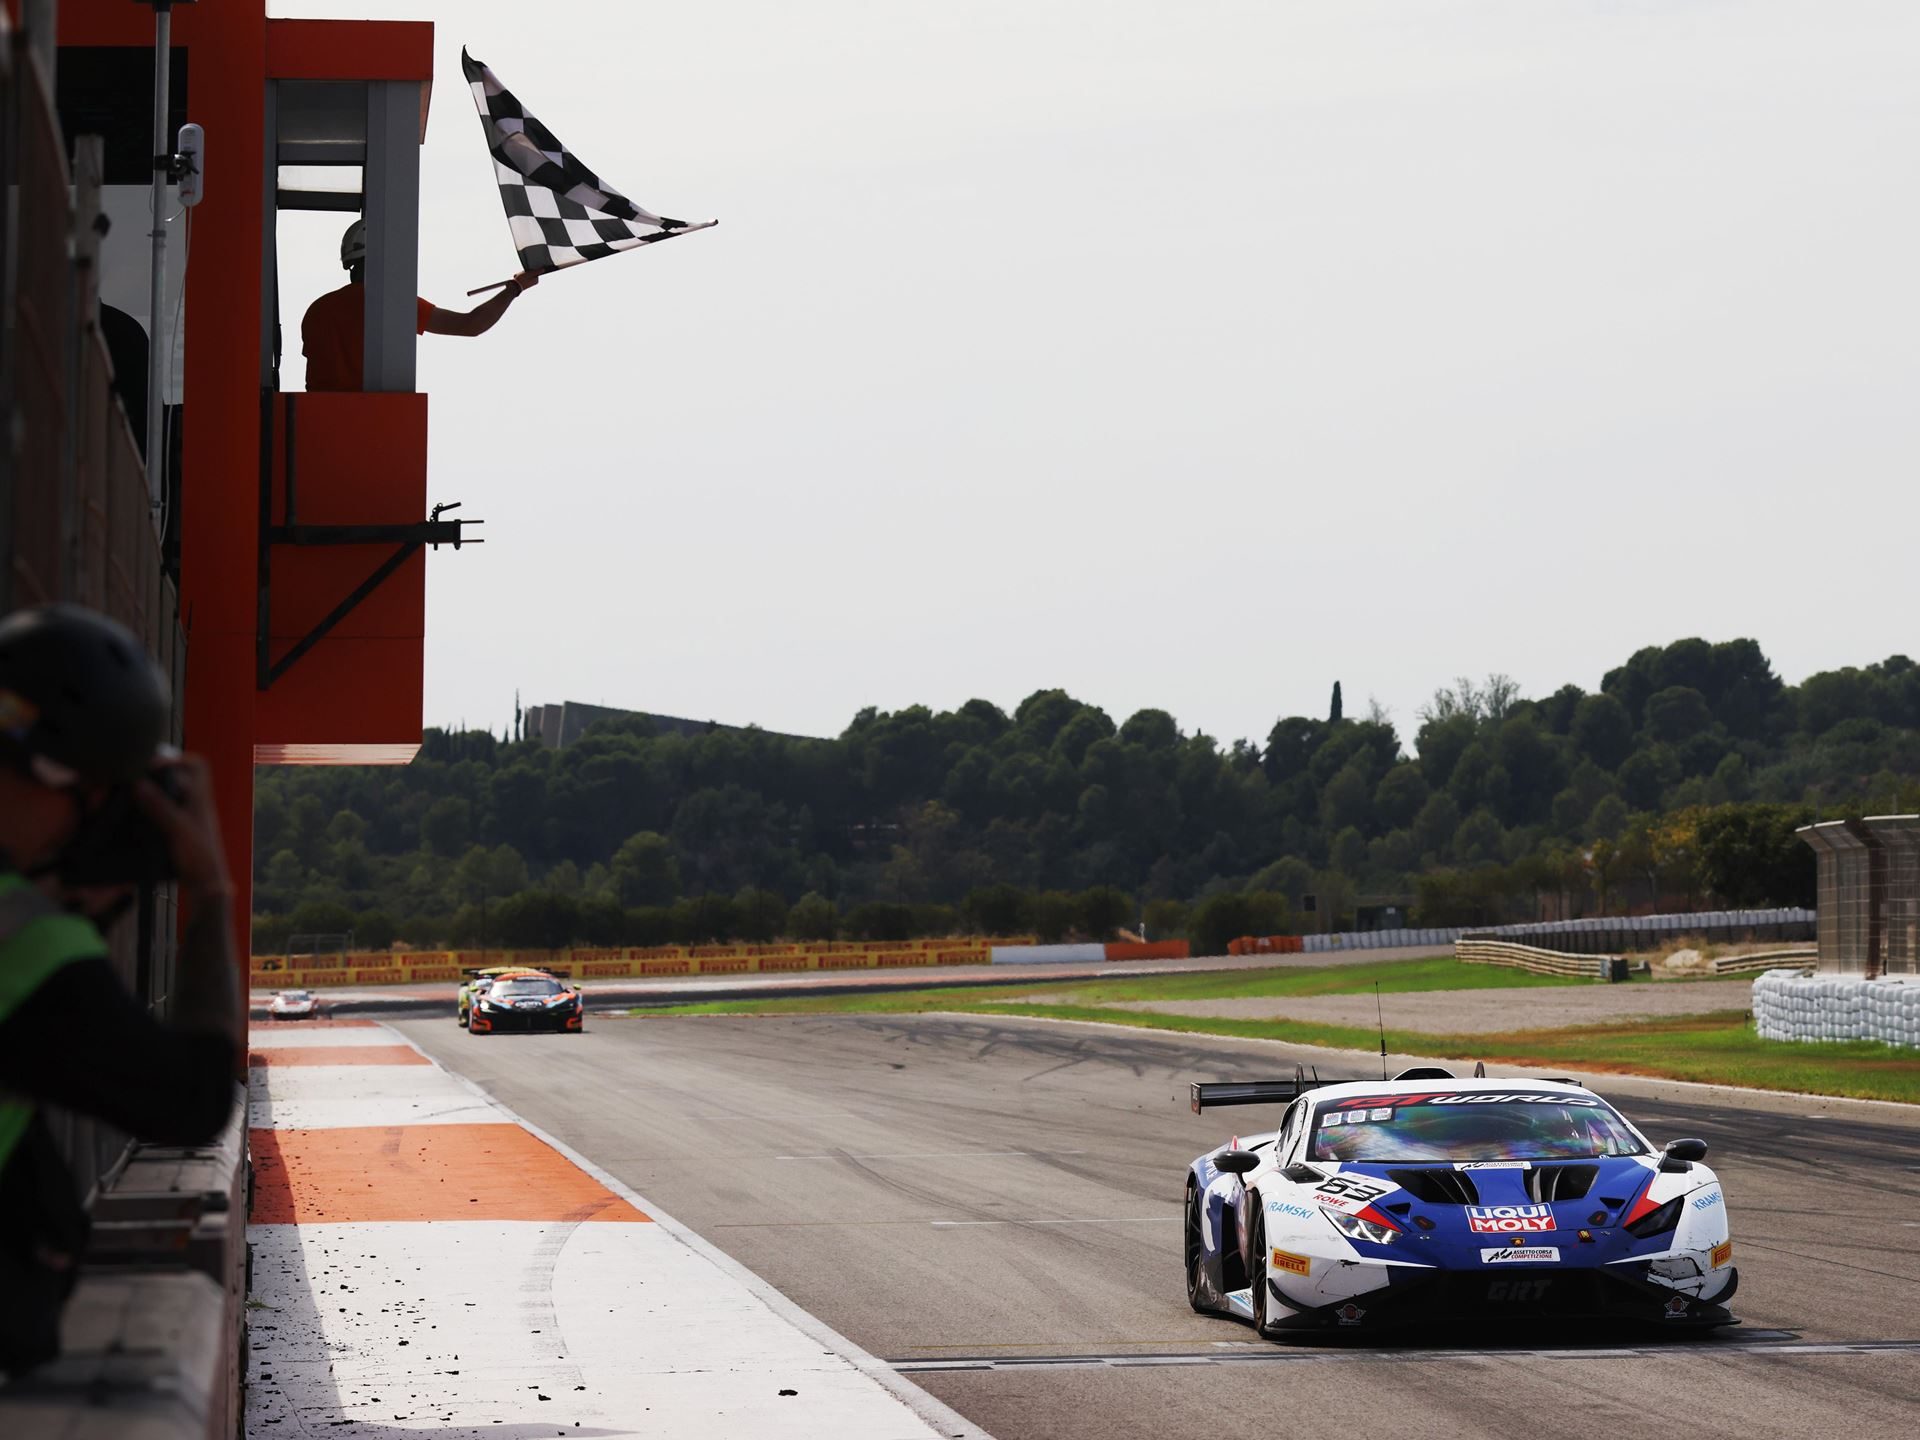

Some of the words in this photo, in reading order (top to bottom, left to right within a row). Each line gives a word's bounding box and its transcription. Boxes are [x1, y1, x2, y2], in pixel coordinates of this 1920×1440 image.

[1315, 1177, 1387, 1202] 63
[1312, 1194, 1349, 1207] ROWE
[1470, 1205, 1548, 1219] LIQUI
[1473, 1216, 1552, 1231] MOLY
[1274, 1252, 1306, 1272] PIRELLI
